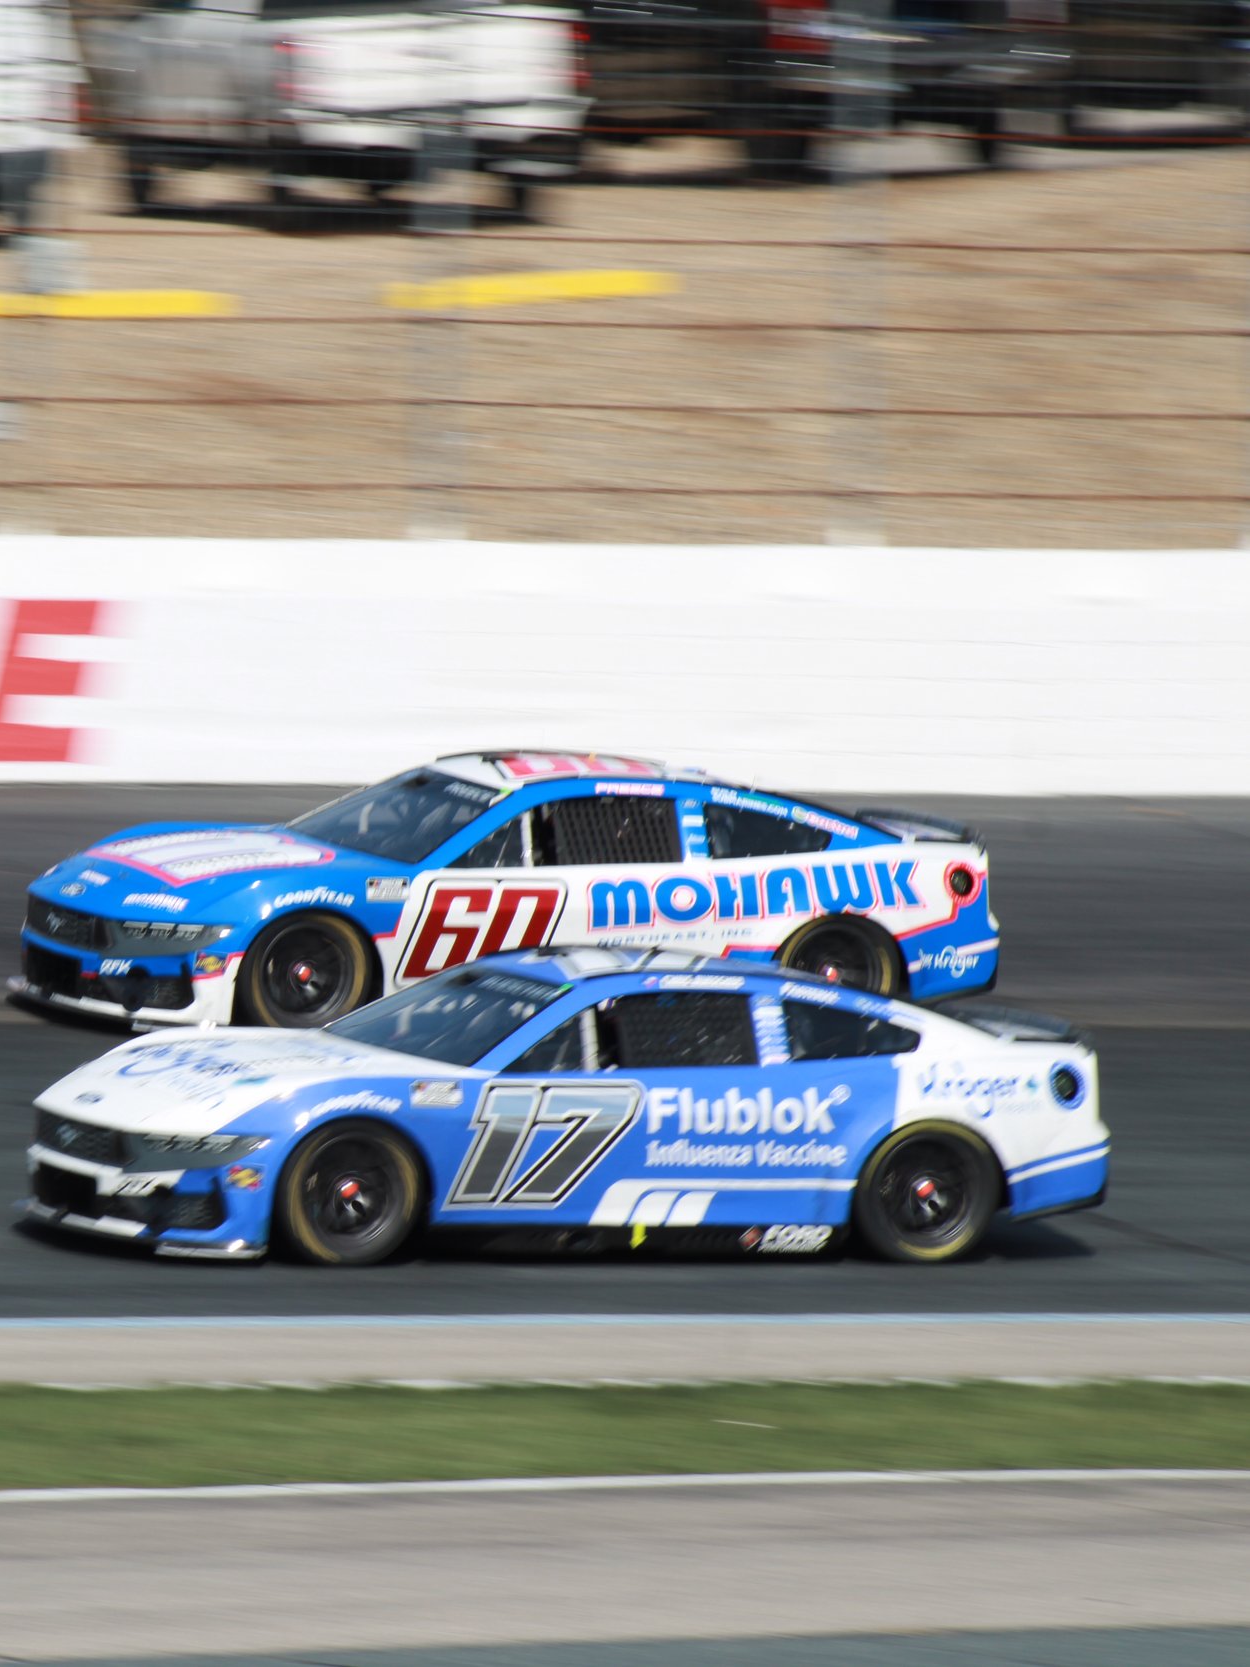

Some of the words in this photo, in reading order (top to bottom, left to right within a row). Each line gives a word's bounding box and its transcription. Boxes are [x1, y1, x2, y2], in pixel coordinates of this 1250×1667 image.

[273, 886, 355, 908] GOODYEAR
[402, 888, 559, 978] 60
[588, 858, 927, 933] MOHAWK
[442, 1080, 645, 1211] 17
[645, 1139, 754, 1168] Influenza
[755, 1139, 848, 1168] Vaccine
